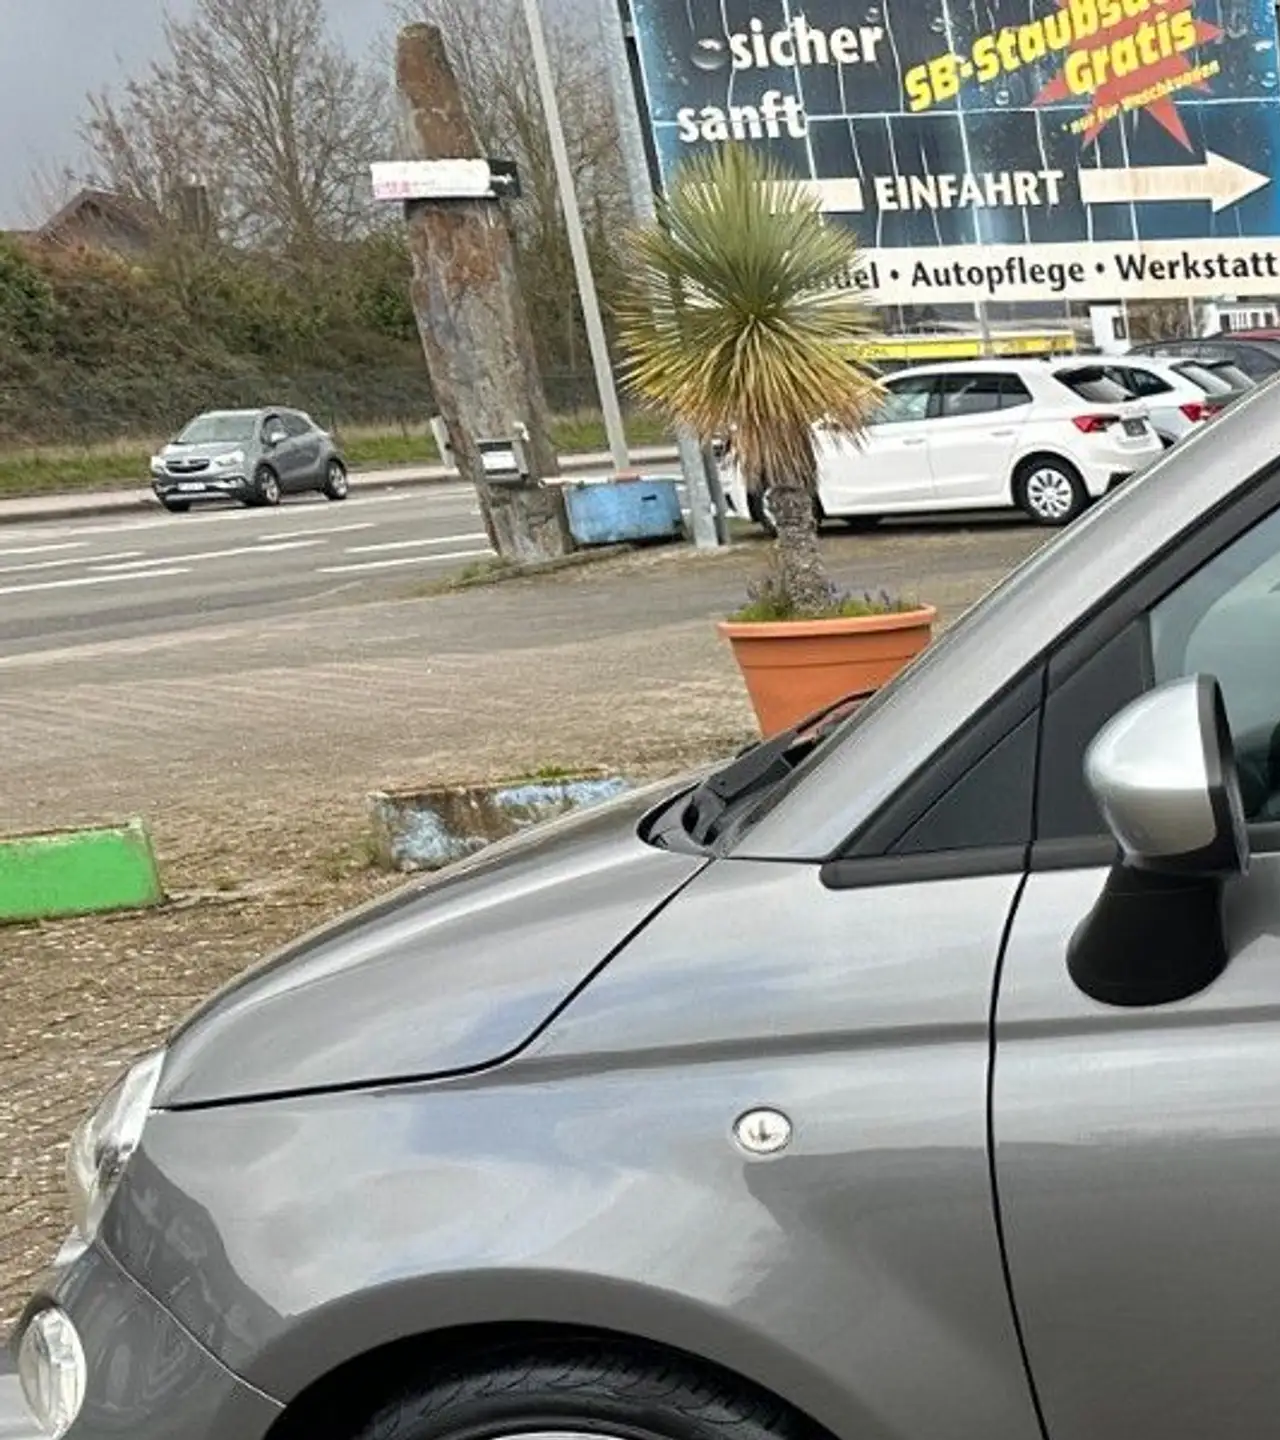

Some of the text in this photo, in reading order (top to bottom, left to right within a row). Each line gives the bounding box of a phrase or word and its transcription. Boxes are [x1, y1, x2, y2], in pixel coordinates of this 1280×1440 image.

[730, 13, 884, 70] sicher
[904, 0, 1168, 111] SB-Staubsa
[1063, 9, 1197, 96] Gratis
[677, 89, 808, 143] sanft
[875, 170, 1064, 211] EINFAHRT
[911, 256, 1086, 292] Autopflege
[1114, 252, 1279, 282] Werkstatt
